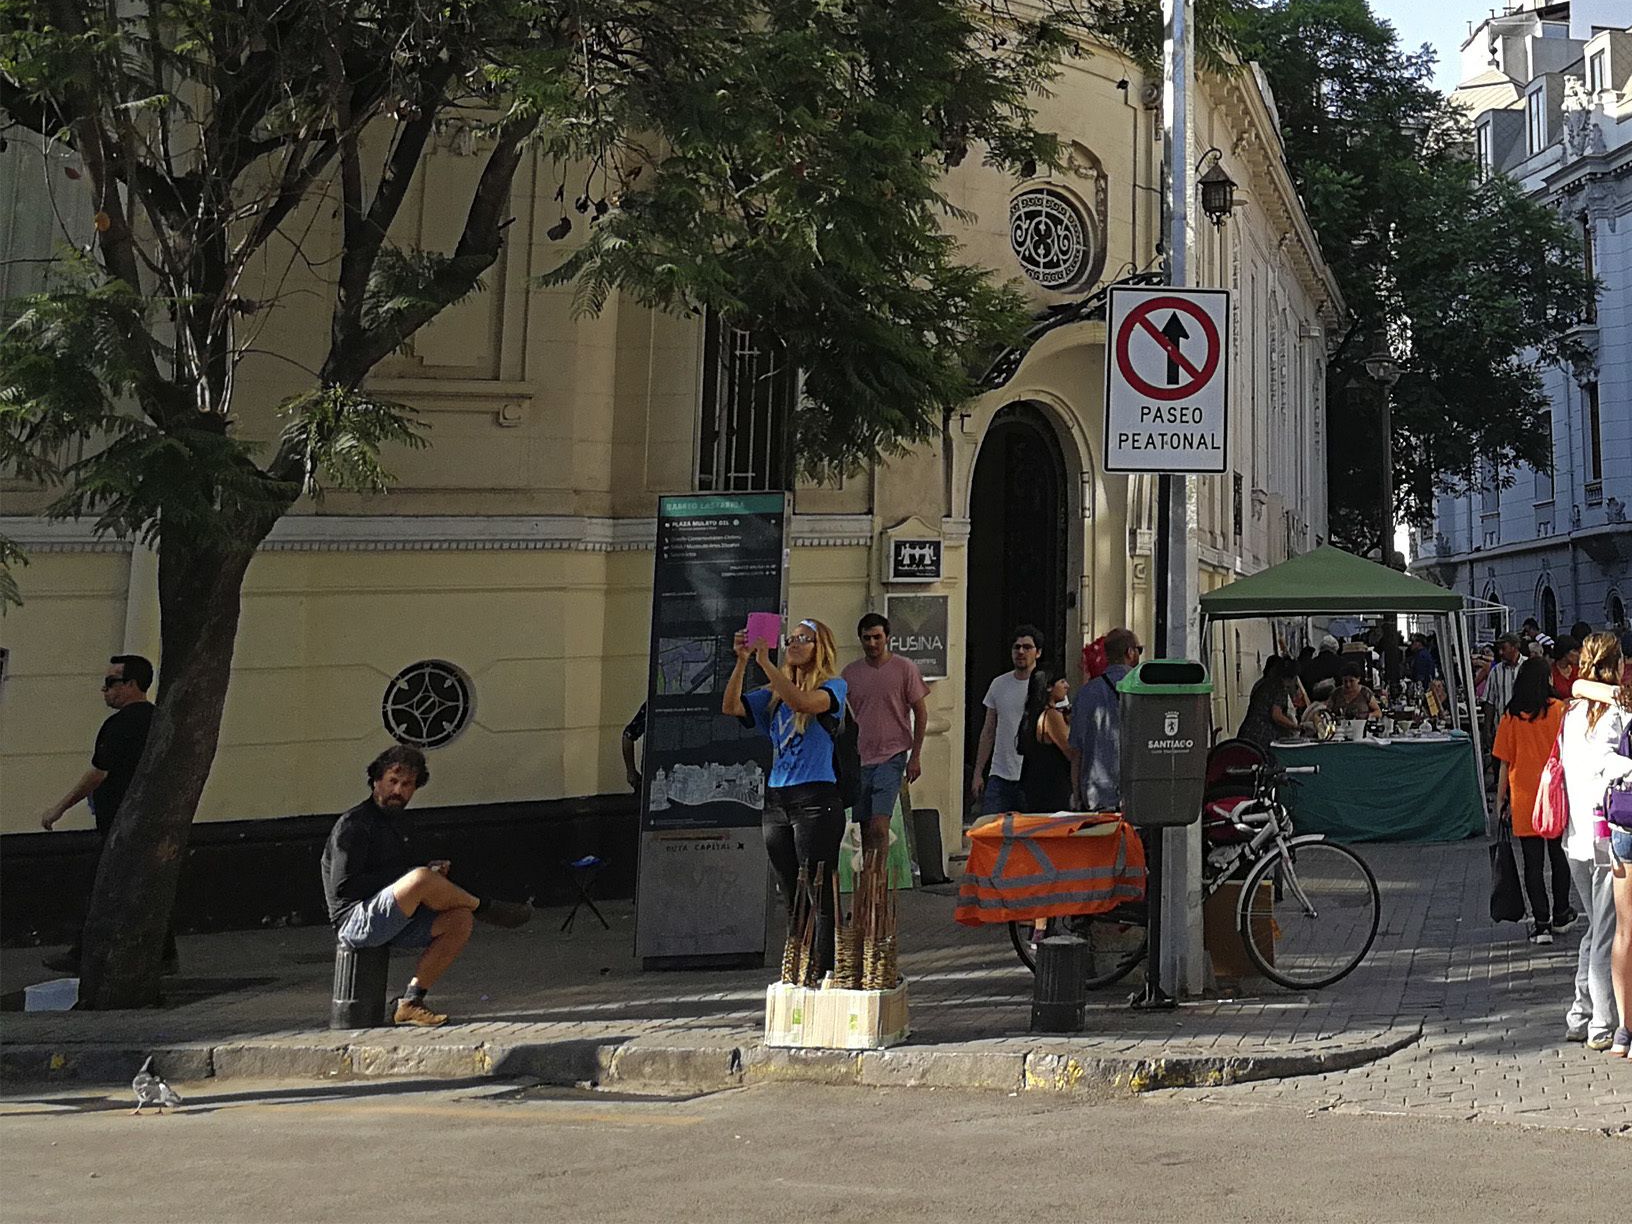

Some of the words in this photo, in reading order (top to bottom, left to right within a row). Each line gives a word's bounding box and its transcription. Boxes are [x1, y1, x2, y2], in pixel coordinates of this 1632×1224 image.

[1140, 406, 1203, 424] PASEO
[1118, 432, 1221, 450] PEATONAL
[672, 520, 691, 528] PLAZA
[889, 636, 943, 651] FUSINA
[1147, 739, 1194, 749] SANTIAGO
[694, 842, 730, 851] CAPITAL
